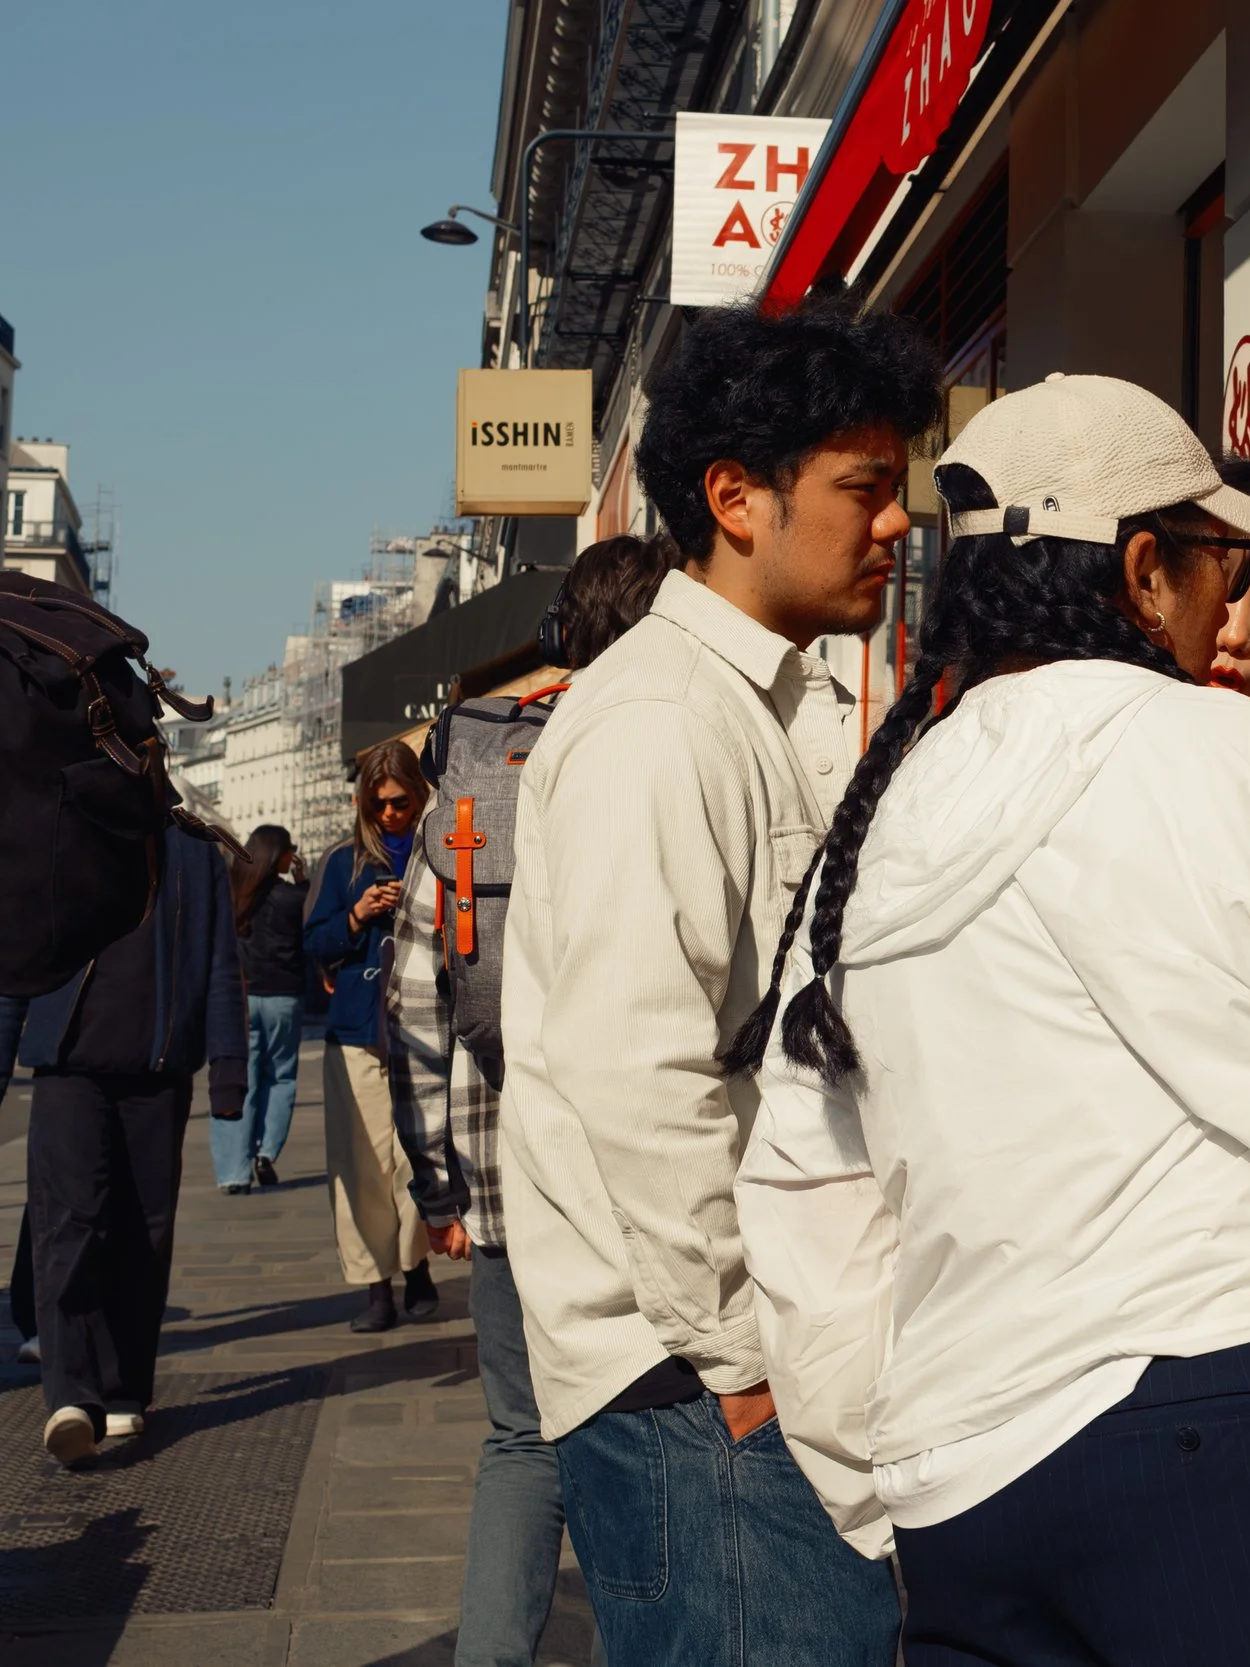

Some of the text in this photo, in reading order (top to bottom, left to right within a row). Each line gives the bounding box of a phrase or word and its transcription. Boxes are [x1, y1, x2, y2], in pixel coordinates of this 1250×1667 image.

[715, 143, 809, 194] ZH
[712, 200, 761, 249] A
[712, 264, 750, 277] 100%
[502, 464, 548, 472] montmartre
